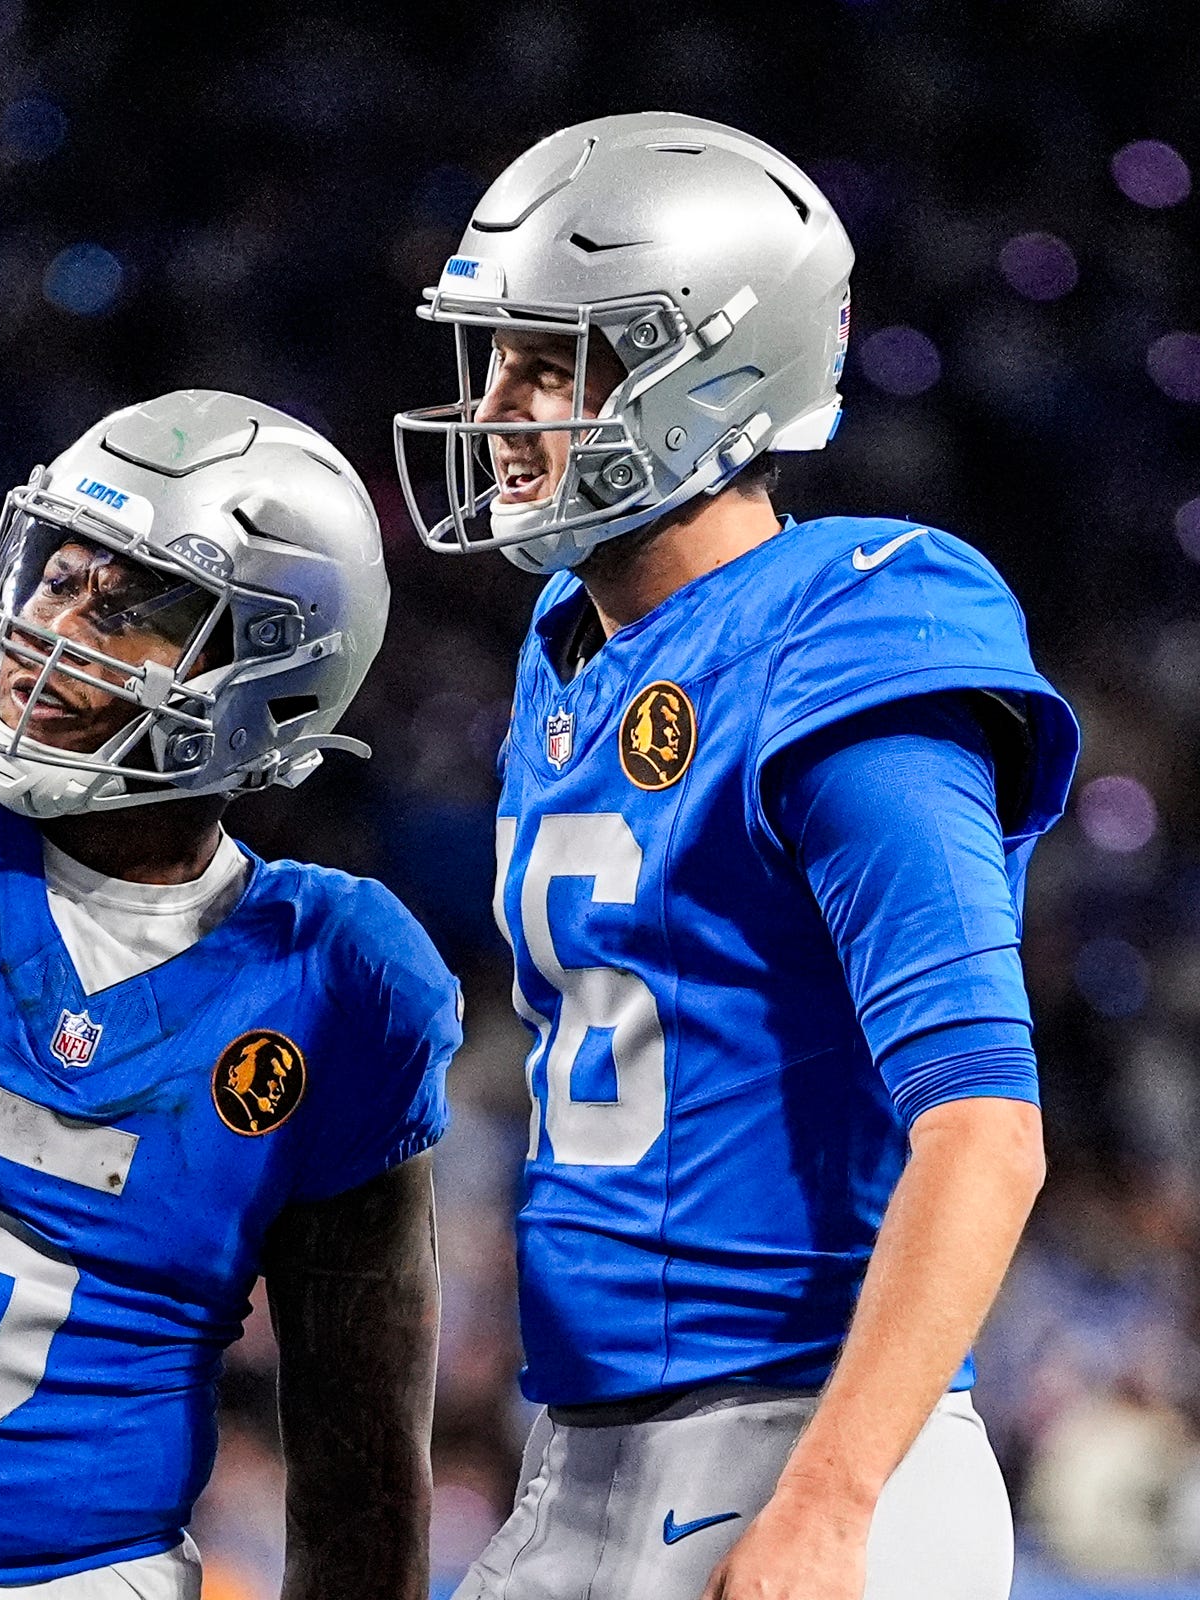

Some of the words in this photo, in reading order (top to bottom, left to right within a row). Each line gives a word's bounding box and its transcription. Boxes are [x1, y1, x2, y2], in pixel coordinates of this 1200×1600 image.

[75, 477, 130, 510] LIONS
[173, 543, 228, 577] OAKLEY
[56, 1032, 89, 1061] NFL
